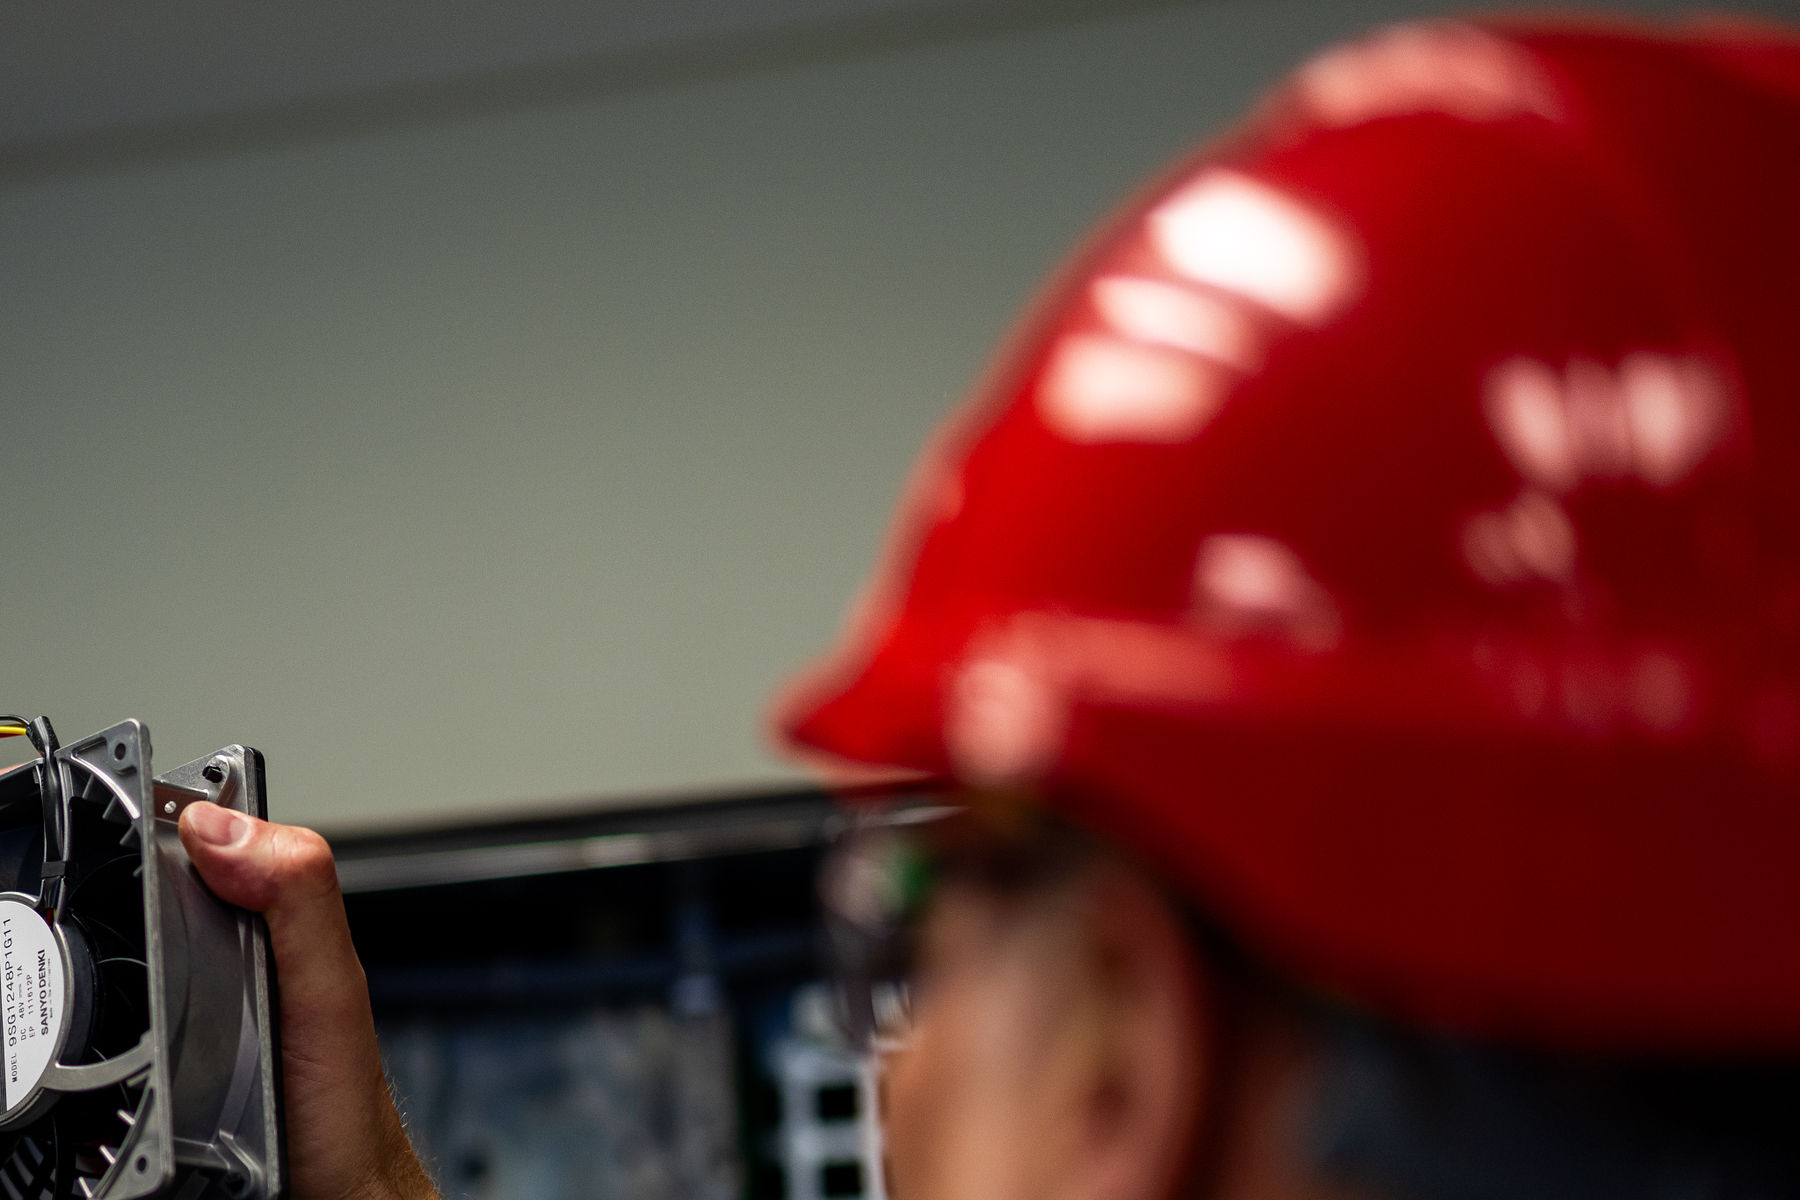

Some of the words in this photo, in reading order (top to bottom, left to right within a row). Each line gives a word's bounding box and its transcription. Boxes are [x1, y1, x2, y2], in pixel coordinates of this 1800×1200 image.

[16, 965, 23, 976] 1A
[38, 949, 46, 988] DENKI
[3, 918, 17, 1047] 9SG1248P1G11
[40, 990, 49, 1035] SANYO
[21, 1028, 27, 1041] DC
[29, 1026, 35, 1038] EP
